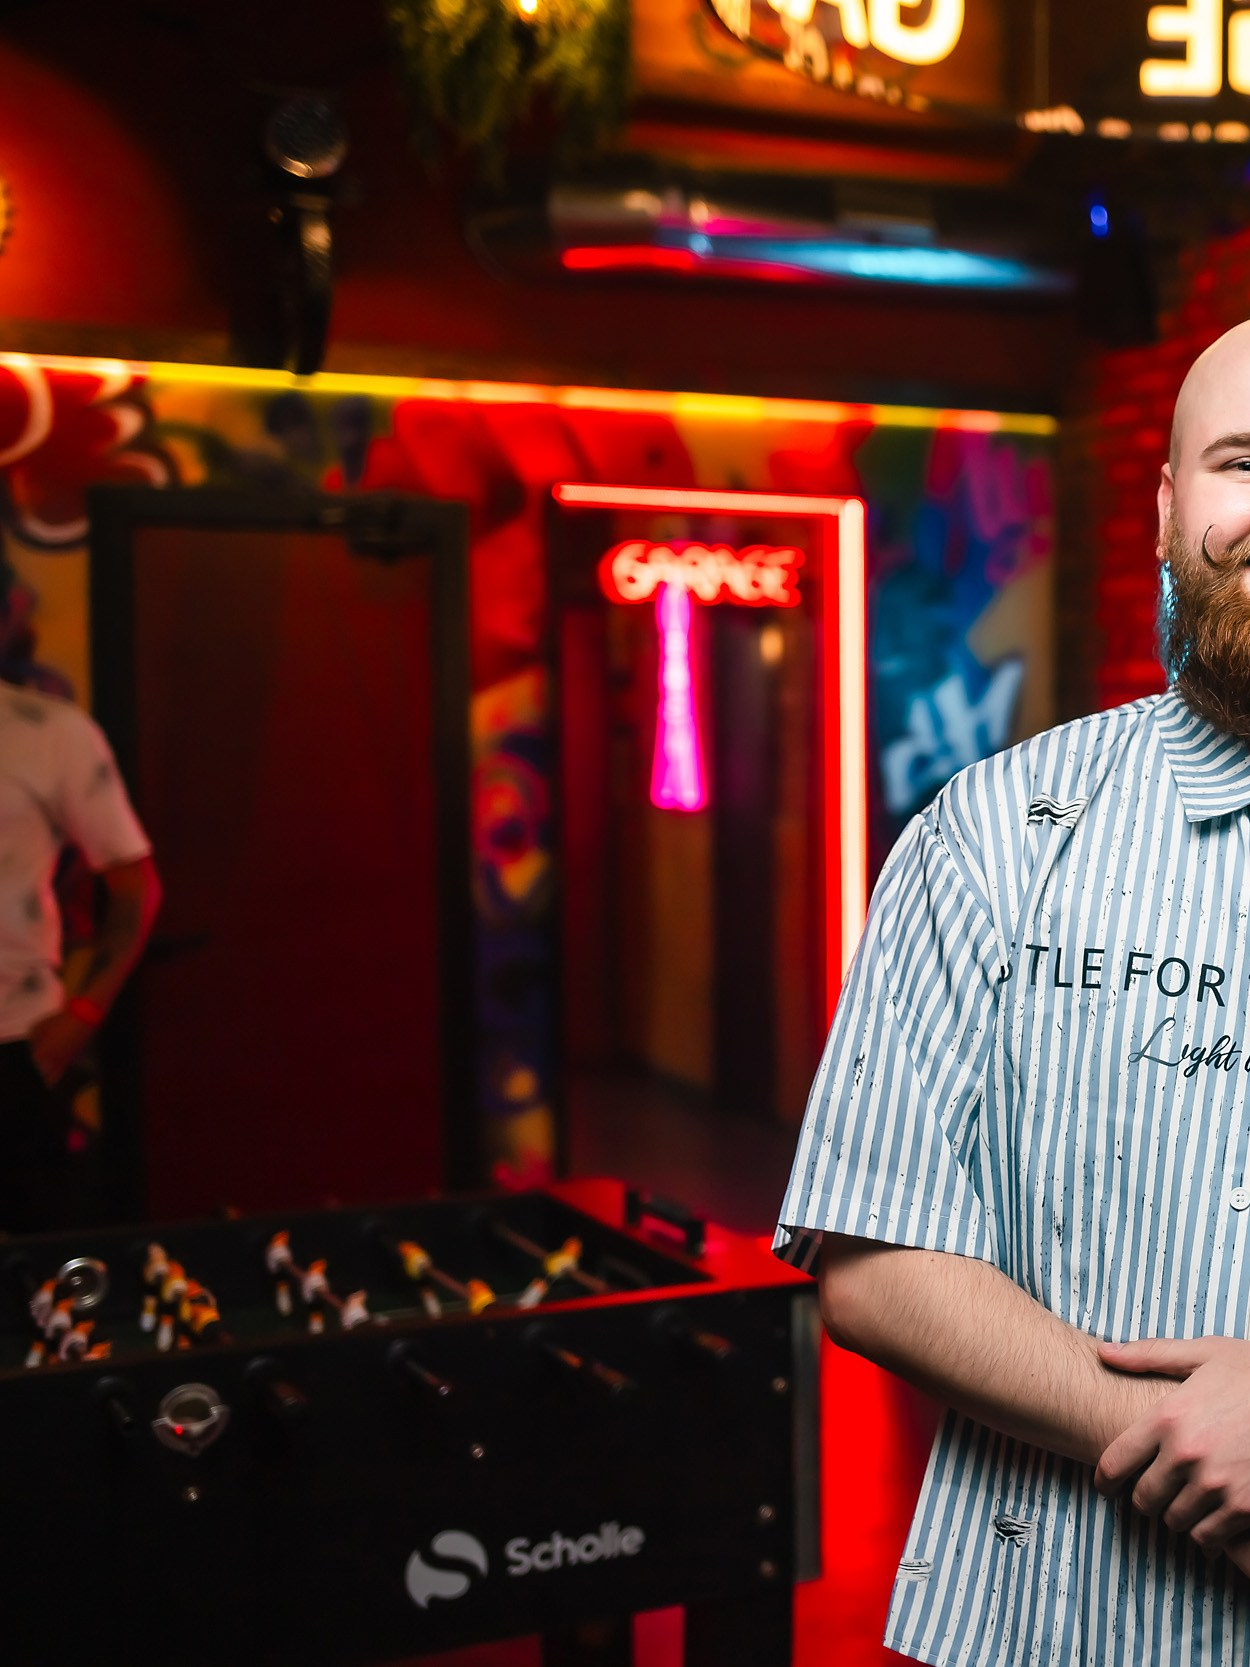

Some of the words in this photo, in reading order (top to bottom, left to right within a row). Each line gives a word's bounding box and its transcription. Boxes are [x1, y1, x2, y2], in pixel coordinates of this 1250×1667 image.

[1124, 951, 1226, 1008] FOR
[1128, 1016, 1243, 1078] Light
[504, 1519, 646, 1577] Scholle
